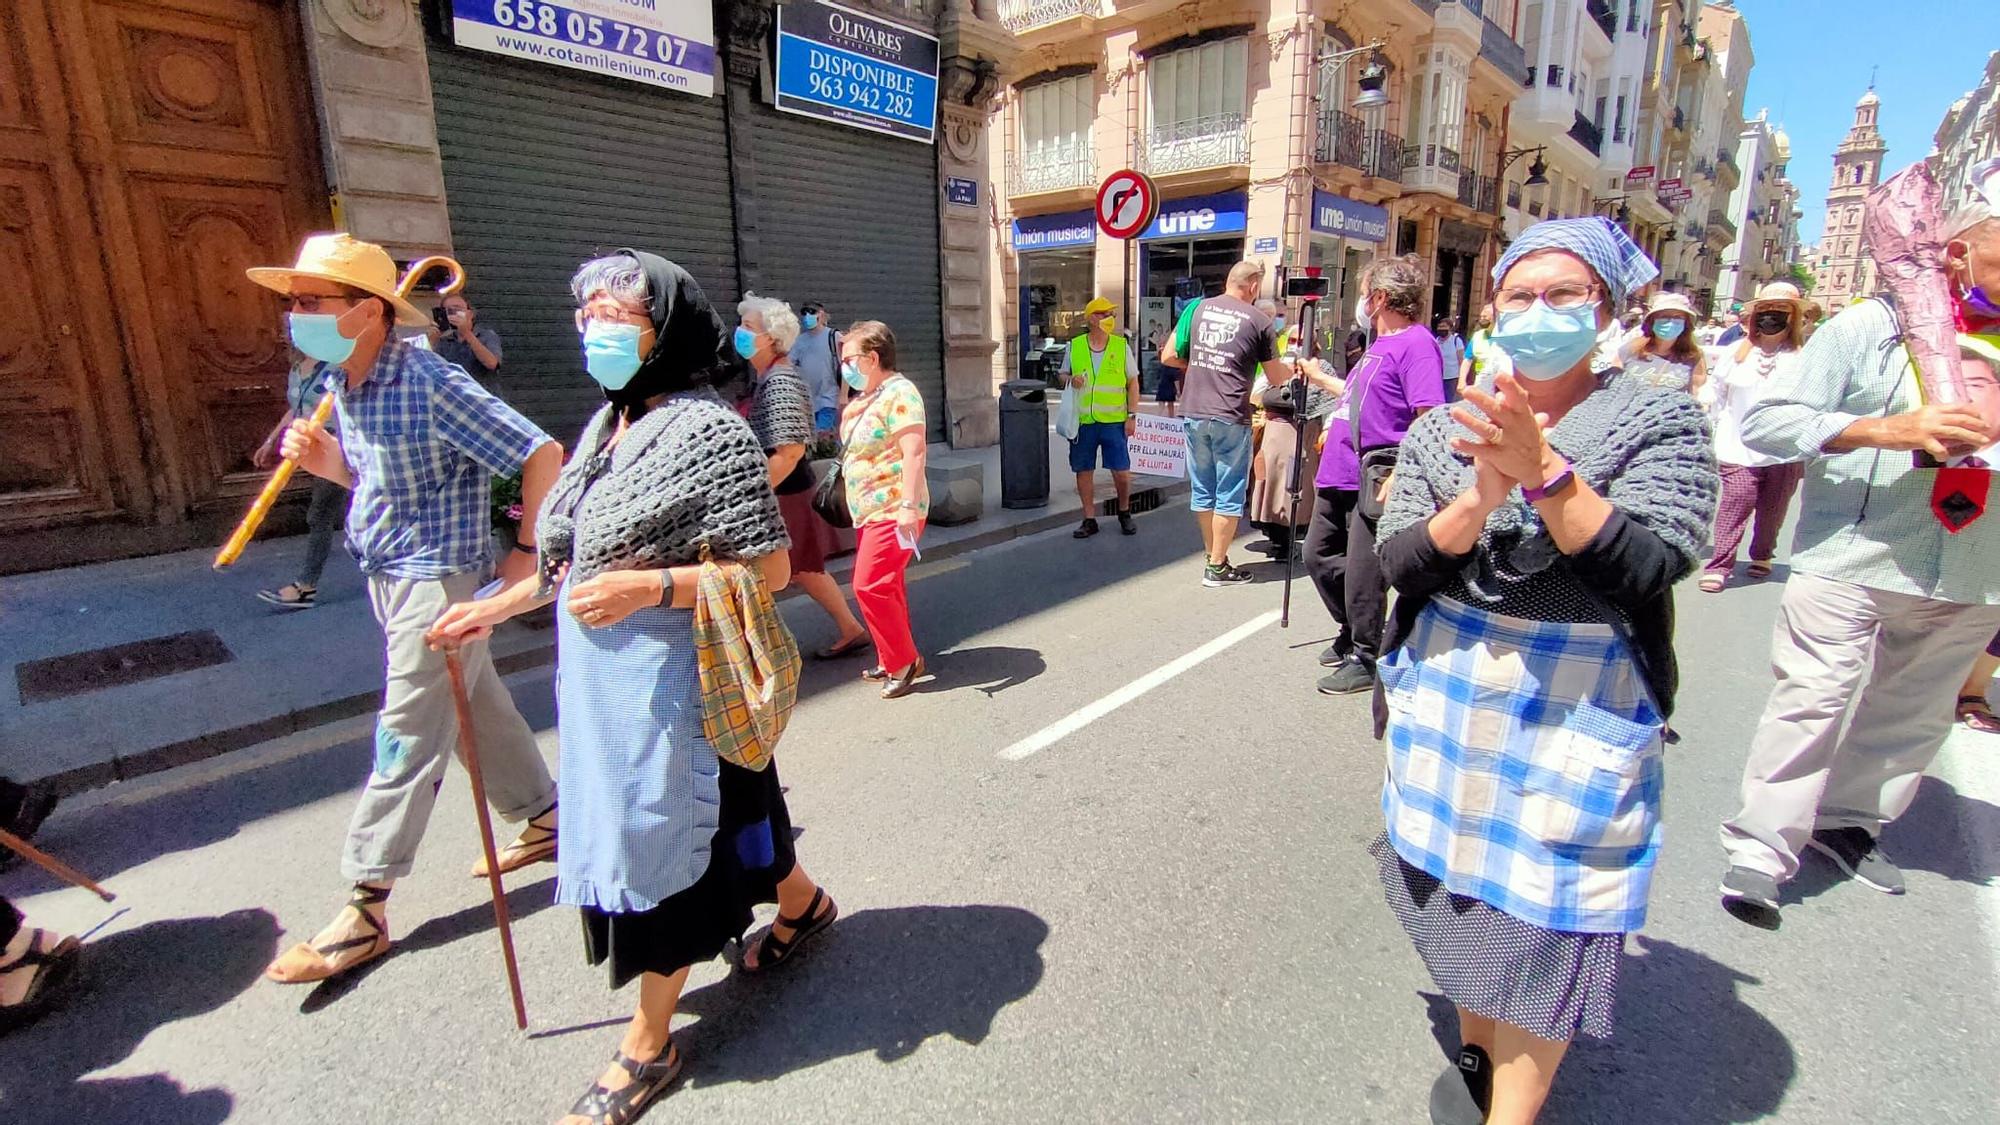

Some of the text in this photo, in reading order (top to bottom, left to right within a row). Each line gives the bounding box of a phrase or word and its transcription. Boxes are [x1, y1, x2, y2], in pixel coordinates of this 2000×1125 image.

[493, 0, 688, 66] 658 05 72 07
[829, 13, 902, 52] OLIVARES
[495, 34, 688, 87] www.cotamilenium.com
[809, 49, 915, 95] DISPONIBLE
[809, 72, 913, 119] 963 942 282
[1015, 226, 1091, 245] unión musical
[1159, 208, 1216, 234] ume
[1320, 206, 1387, 238] ume unión musical
[1137, 418, 1183, 433] SI LA VIDRIOLA
[1149, 434, 1185, 445] RECUPERAR
[1129, 444, 1141, 453] PER
[1142, 446, 1157, 456] ELLA
[1138, 458, 1173, 470] DE LLUITAR
